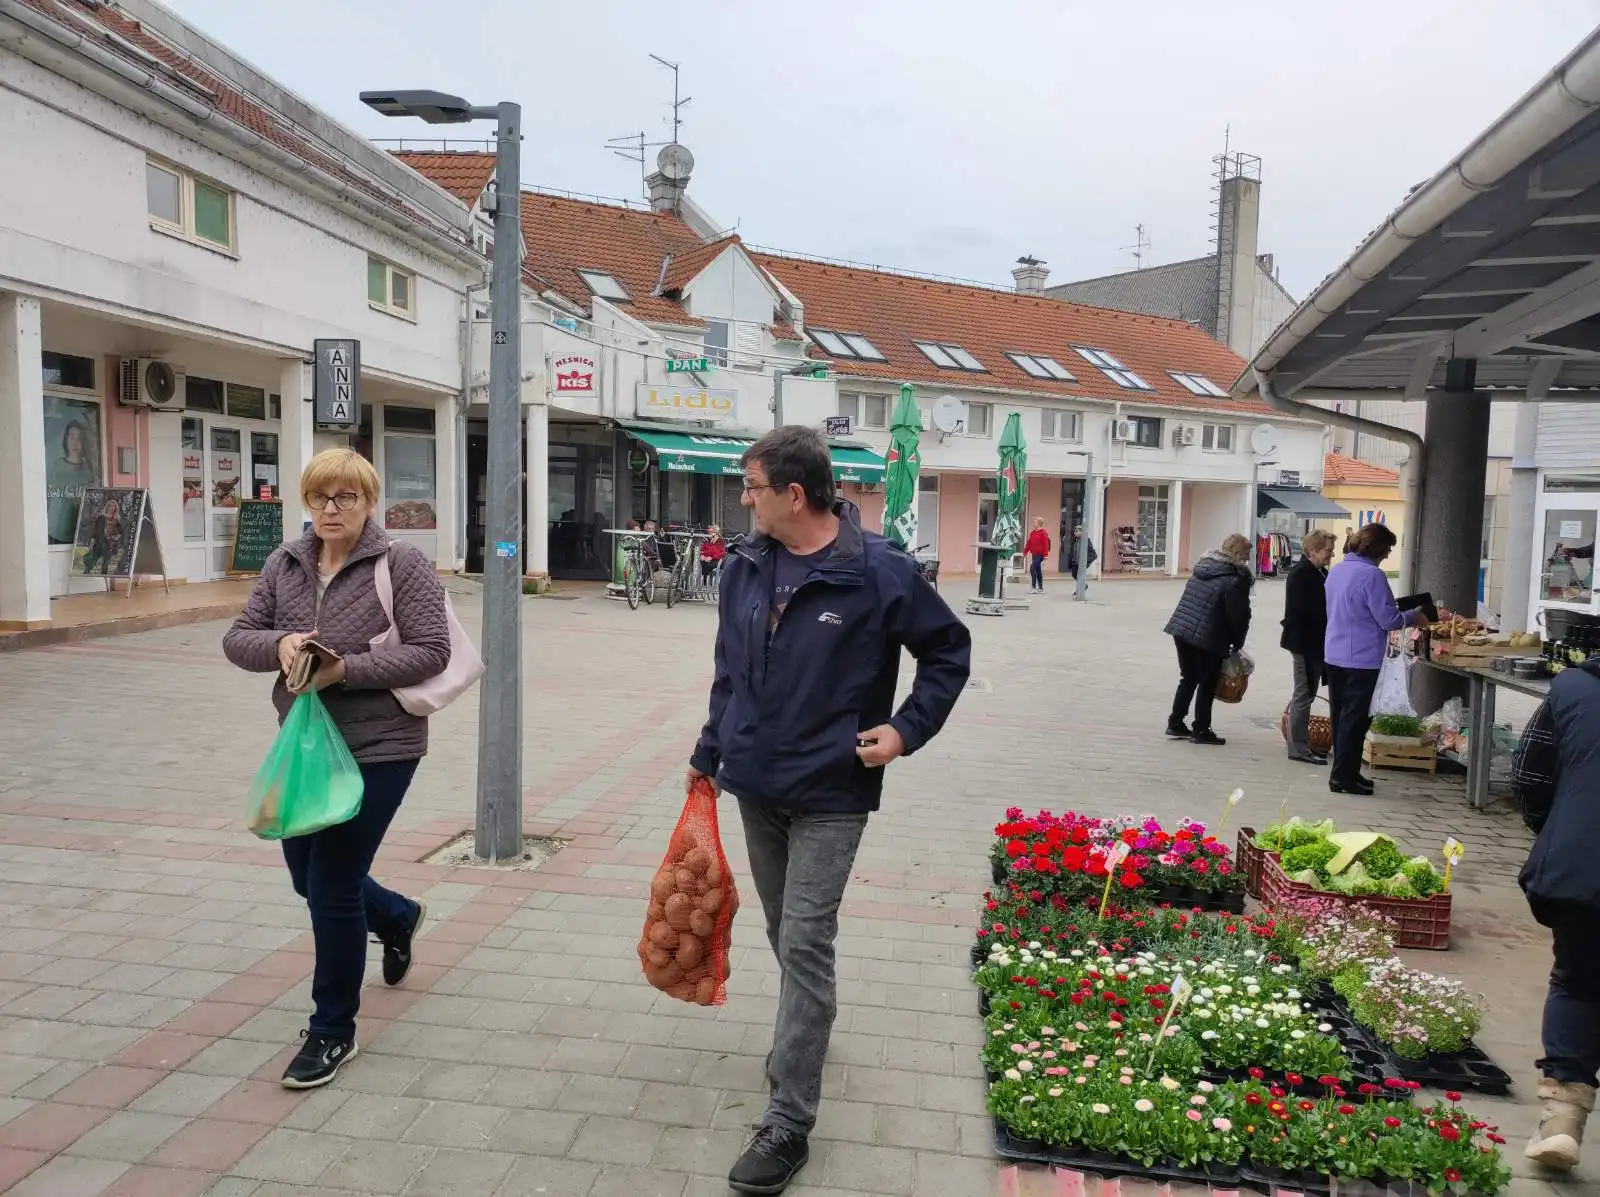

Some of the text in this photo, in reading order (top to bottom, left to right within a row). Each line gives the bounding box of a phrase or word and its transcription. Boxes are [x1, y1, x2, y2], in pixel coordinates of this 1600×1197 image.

[555, 356, 594, 368] MESNICA
[673, 360, 701, 371] PAN
[331, 349, 349, 418] ANNA
[647, 389, 732, 409] Lido
[668, 462, 695, 471] Heineken
